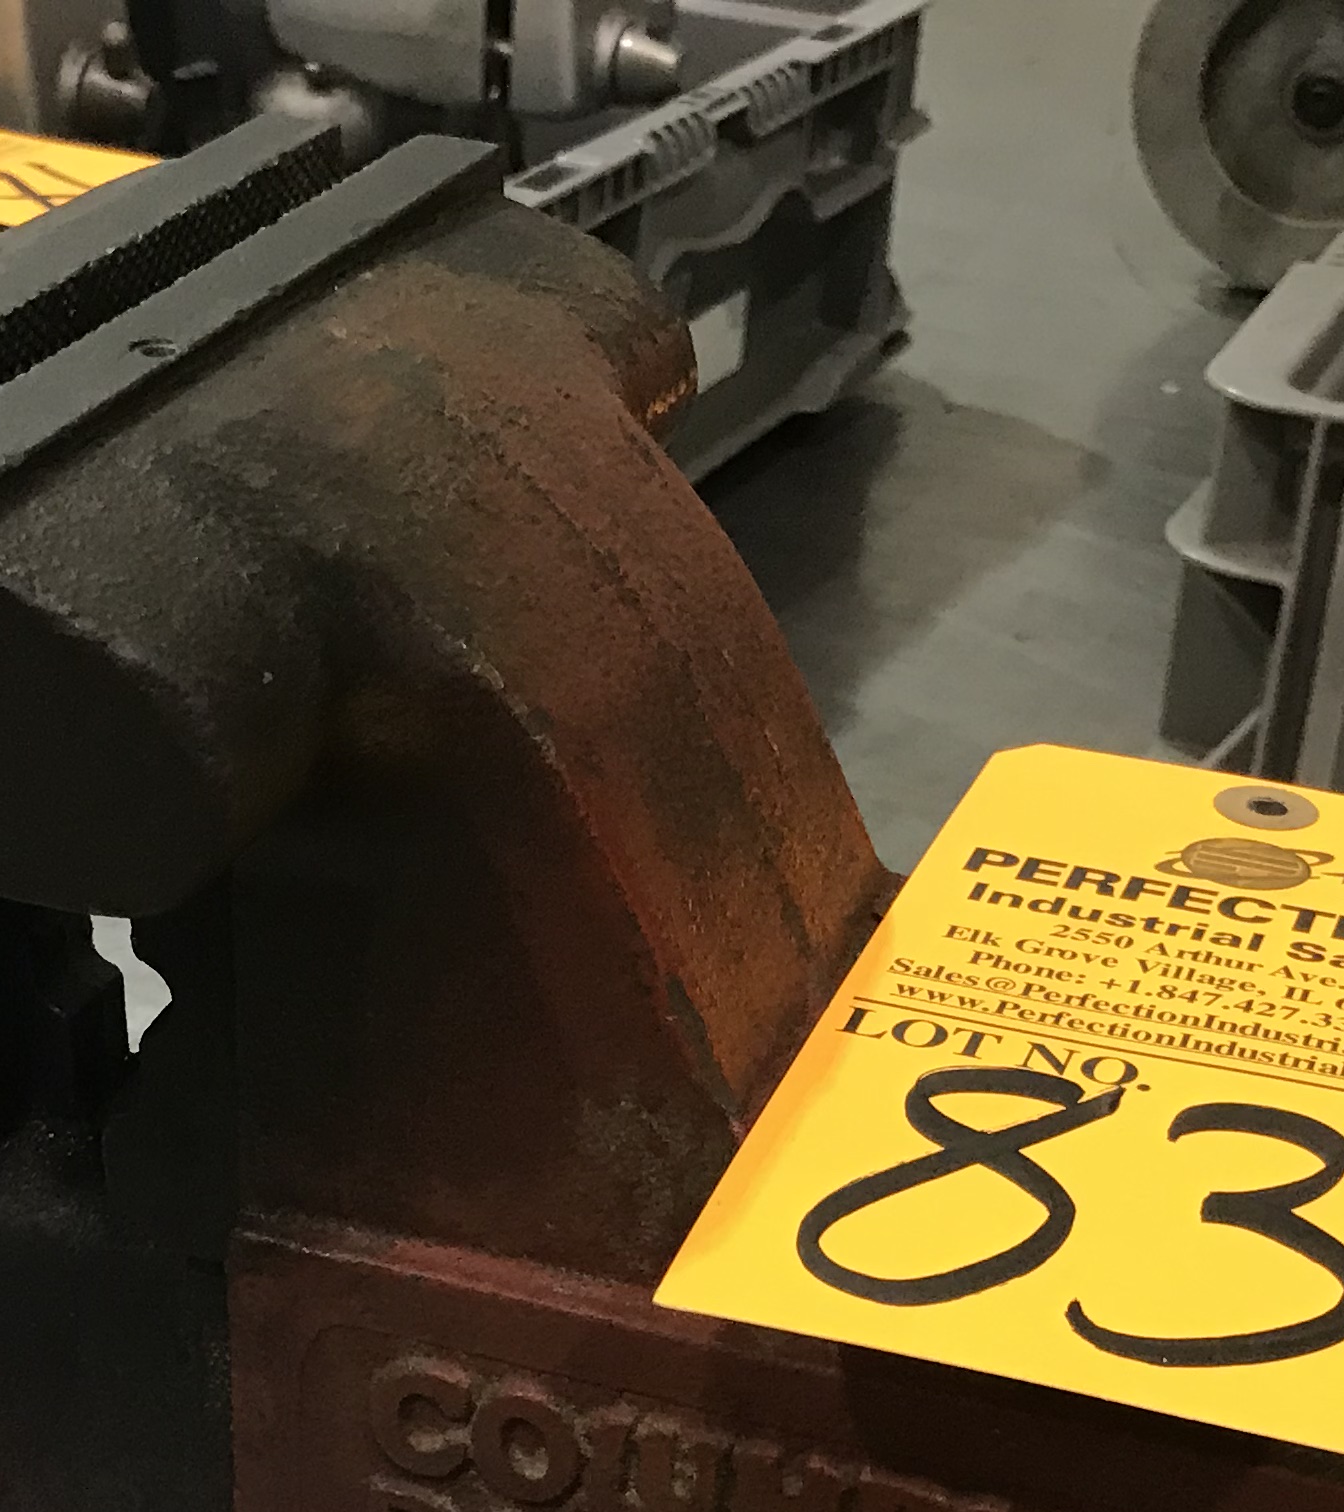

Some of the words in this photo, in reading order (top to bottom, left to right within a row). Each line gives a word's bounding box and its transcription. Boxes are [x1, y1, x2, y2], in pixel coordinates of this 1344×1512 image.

[967, 881, 1266, 953] Industrial
[1049, 924, 1134, 950] 2550
[1144, 941, 1264, 973] Arthur
[941, 924, 1003, 948] Elk
[1014, 937, 1119, 968] Grove
[1135, 958, 1266, 997] Village,
[1280, 985, 1323, 1006] IL
[968, 950, 1086, 985] Phone:
[835, 1005, 1004, 1059] LOT
[1015, 1041, 1152, 1092] NO.
